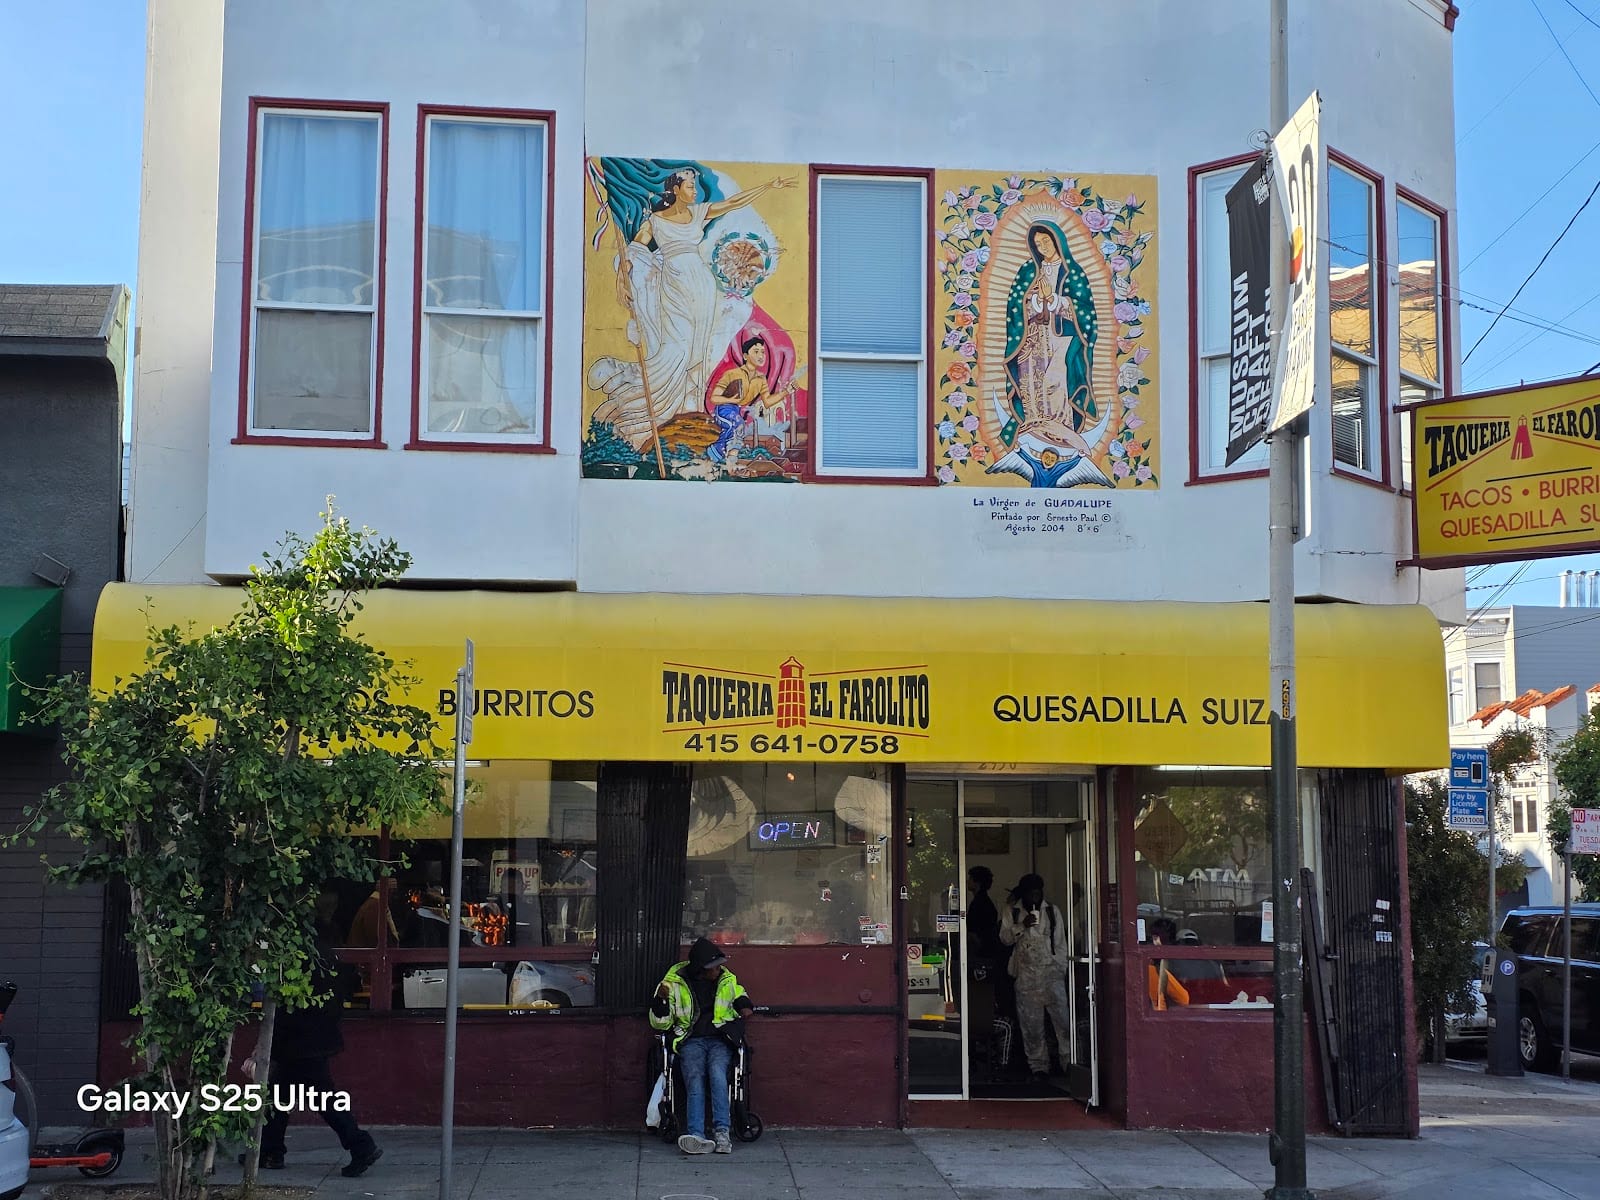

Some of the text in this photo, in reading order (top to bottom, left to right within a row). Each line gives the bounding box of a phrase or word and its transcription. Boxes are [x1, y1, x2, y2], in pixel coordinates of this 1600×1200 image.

[1229, 271, 1250, 443] MUSEUM
[1242, 313, 1265, 434] CRAFT
[1425, 421, 1511, 478] TAQUERIA
[1533, 413, 1545, 432] EL
[973, 497, 1113, 511] La Virgen de GUADALUPE
[1440, 485, 1513, 511] TACOS
[991, 512, 1023, 521] Pintado
[1027, 515, 1040, 523] por
[1046, 513, 1078, 522] Ernesto
[1080, 514, 1098, 522] Paul
[1440, 507, 1567, 538] QUESADILLA
[1004, 524, 1036, 536] Agosto
[1041, 524, 1065, 532] 2004
[662, 670, 930, 730] TAQUERIA EL FAROLITO
[993, 694, 1272, 726] QUESADILLA SUIZ
[684, 733, 899, 755] 415 641-0758
[1451, 751, 1485, 763] Pay here
[1451, 792, 1476, 802] Pay by
[1451, 800, 1479, 808] License
[1451, 807, 1471, 816] Plate
[1573, 810, 1585, 822] NO
[758, 821, 820, 841] OPEN
[1580, 836, 1600, 844] TUESD
[1186, 867, 1250, 884] ATM
